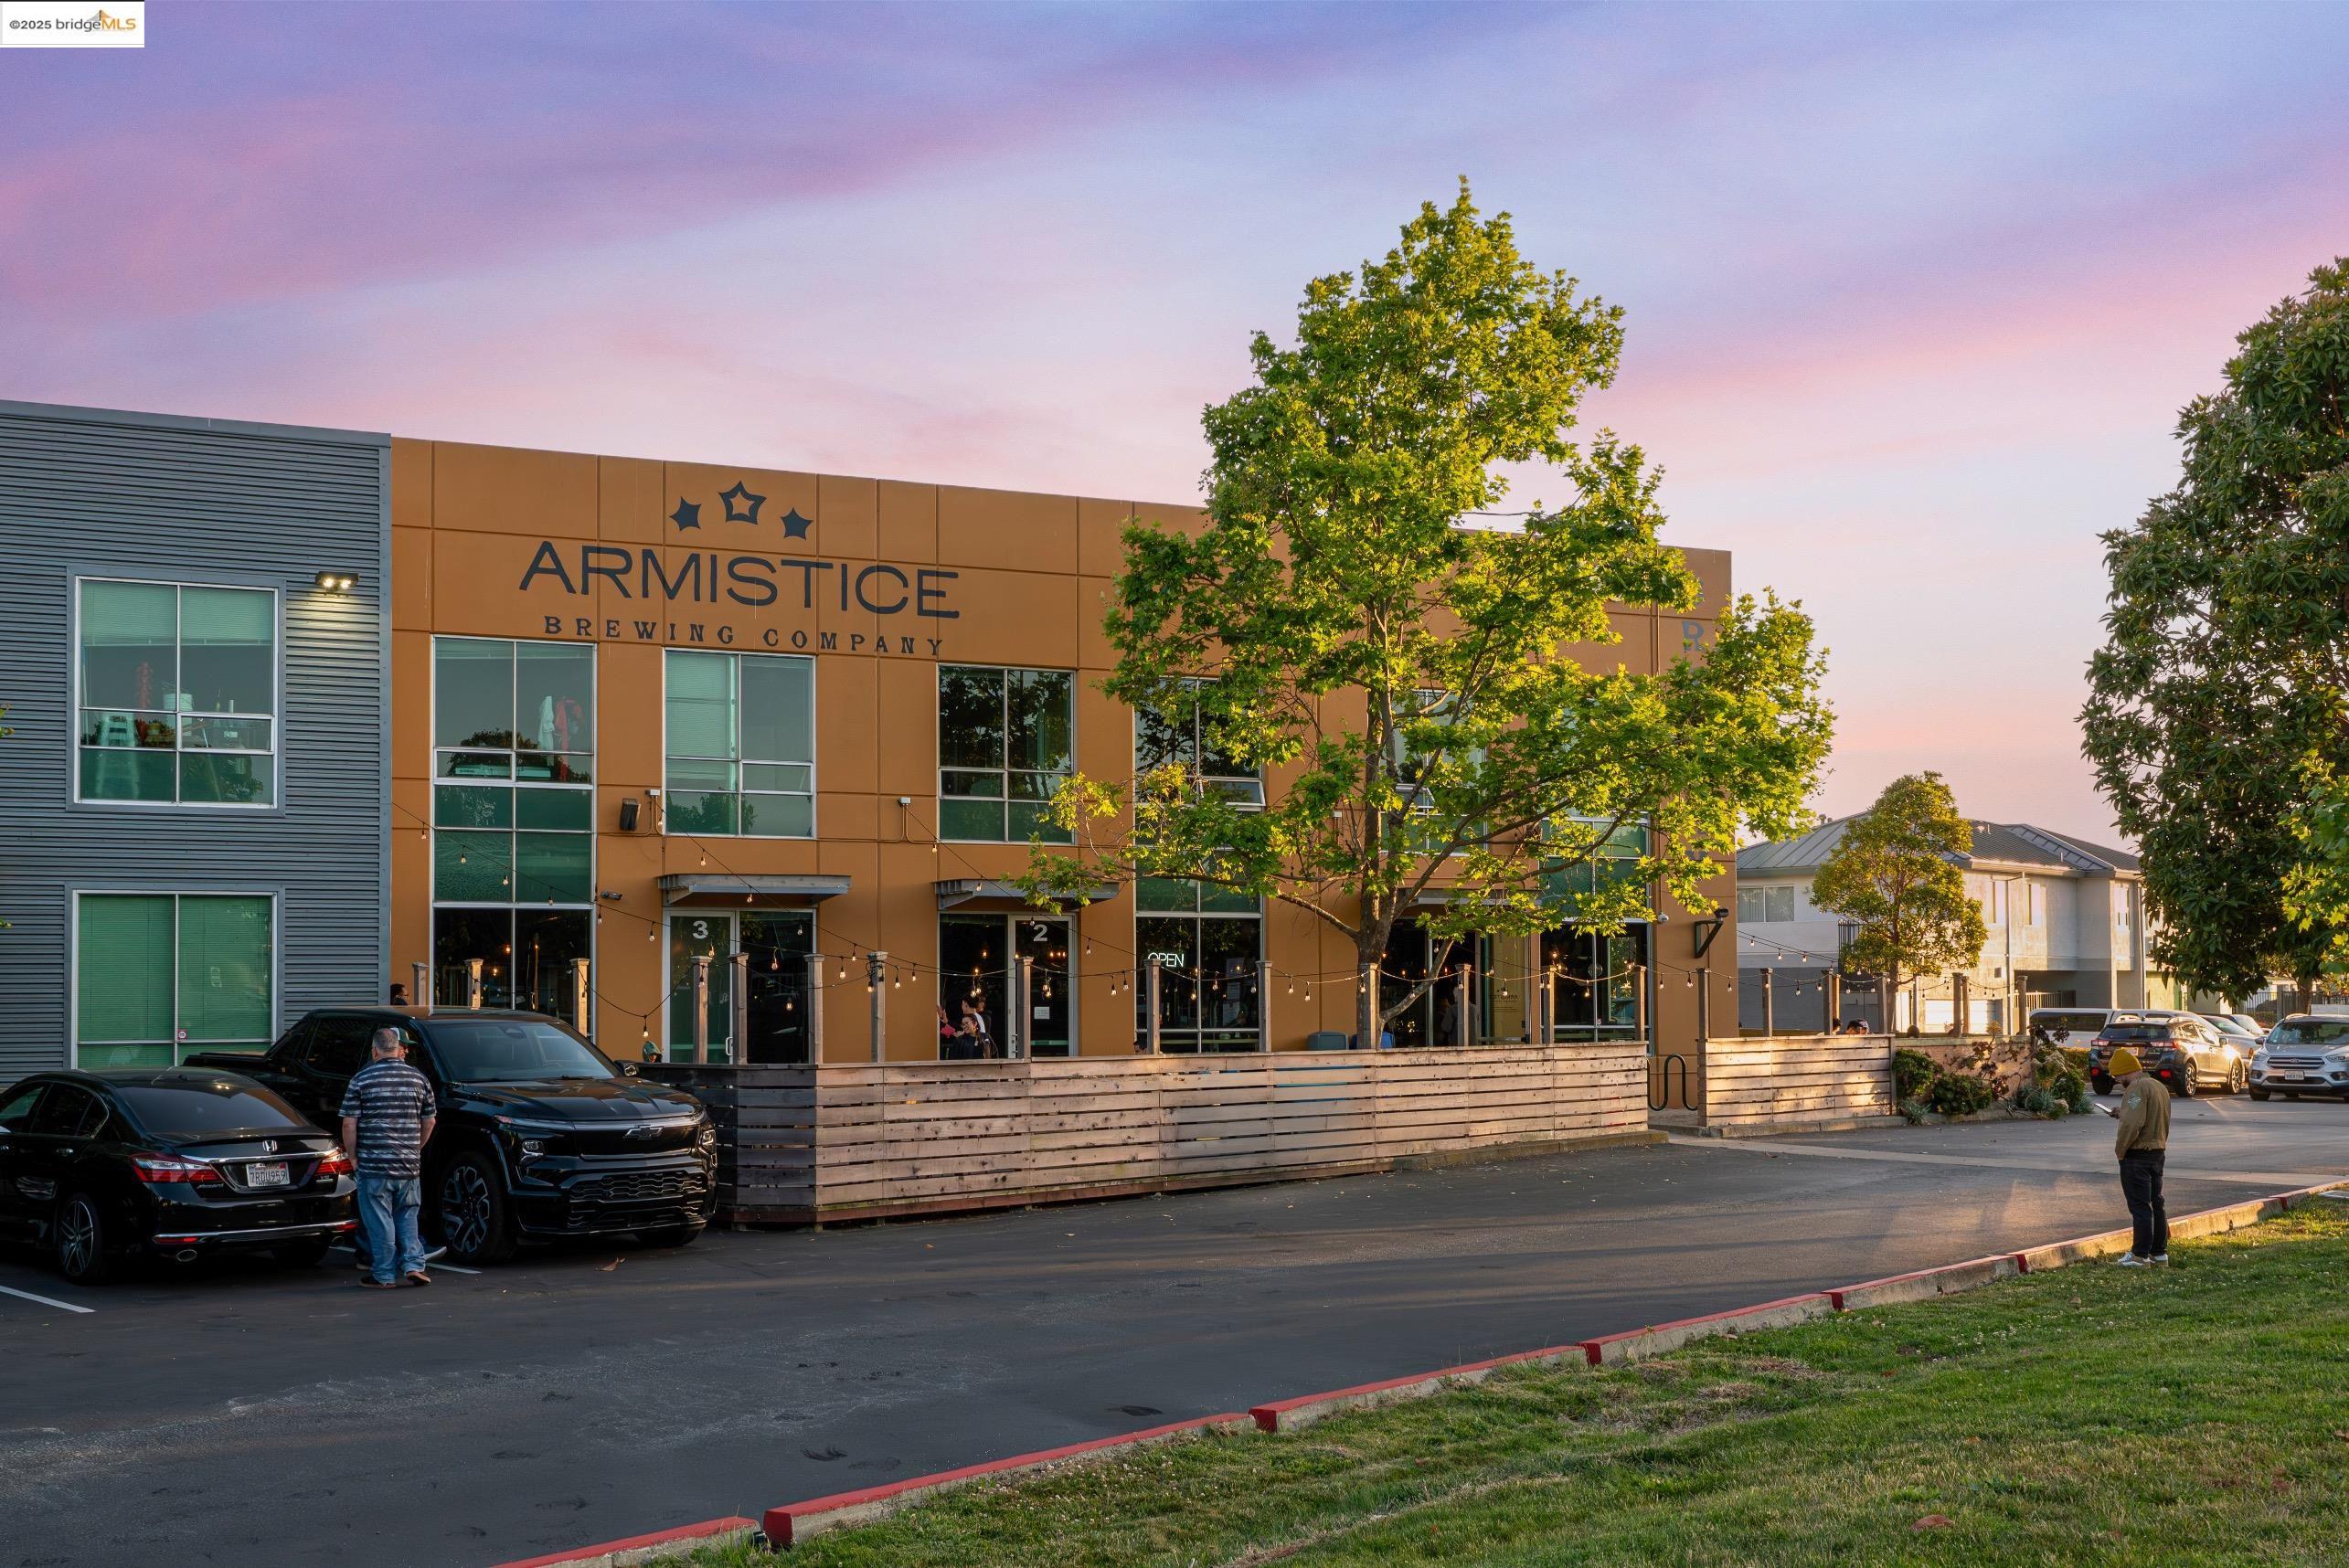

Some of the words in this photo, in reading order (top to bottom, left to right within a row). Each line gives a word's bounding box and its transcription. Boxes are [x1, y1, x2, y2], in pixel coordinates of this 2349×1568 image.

[519, 541, 961, 619] ARMISTICE
[544, 616, 735, 645] BREWING
[762, 628, 944, 656] COMPANY
[693, 920, 708, 939] 3
[1033, 924, 1047, 942] 2
[250, 1170, 286, 1182] 7RDU959
